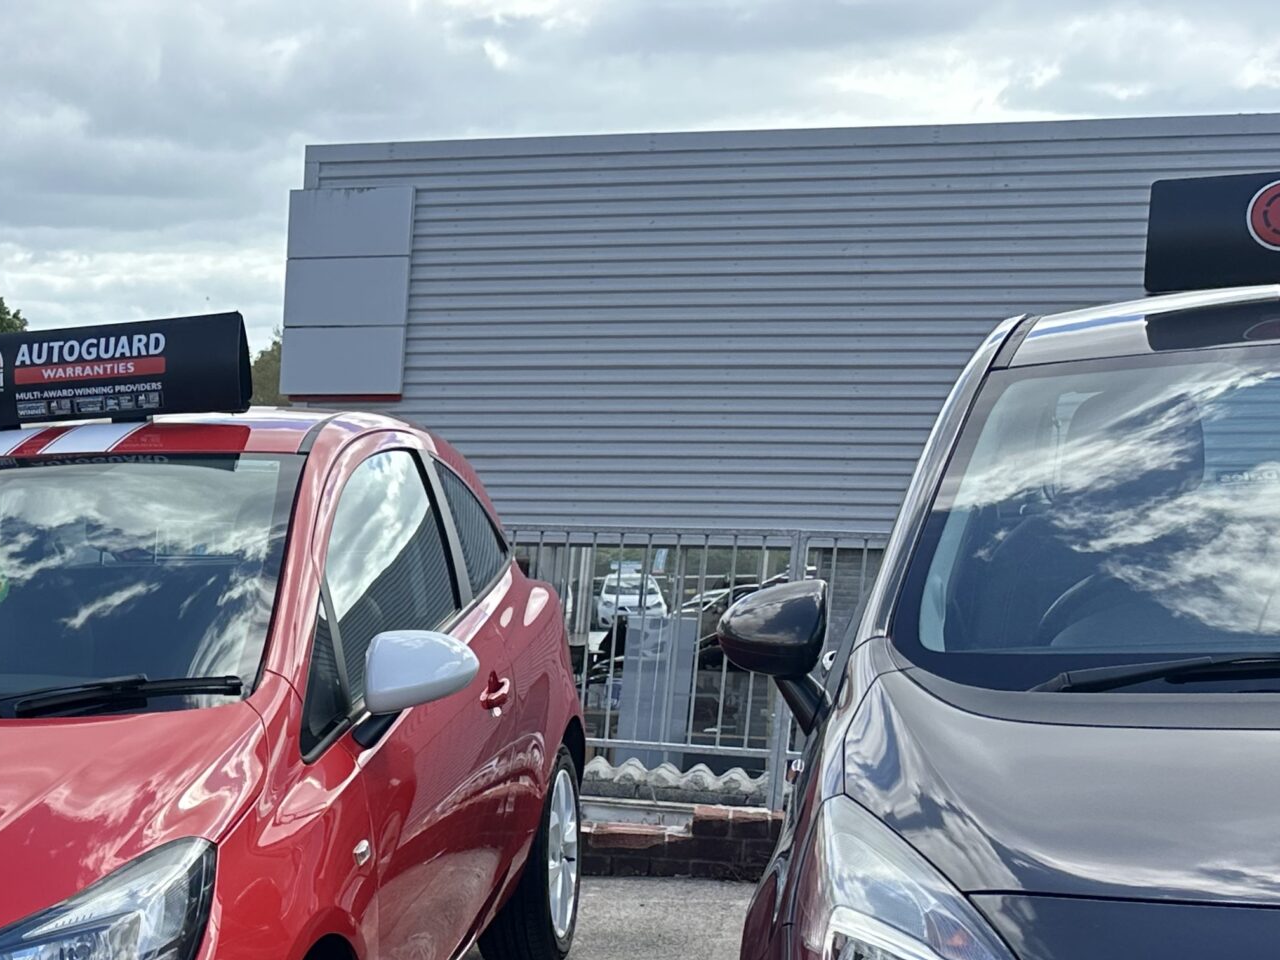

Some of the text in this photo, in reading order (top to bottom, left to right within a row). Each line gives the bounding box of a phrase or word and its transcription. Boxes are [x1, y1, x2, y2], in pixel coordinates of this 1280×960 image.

[14, 332, 166, 366] AUTOGUARD
[42, 362, 135, 380] WARRANTIES
[15, 382, 162, 400] MULTI-AWARD WINNING PROVIDERS
